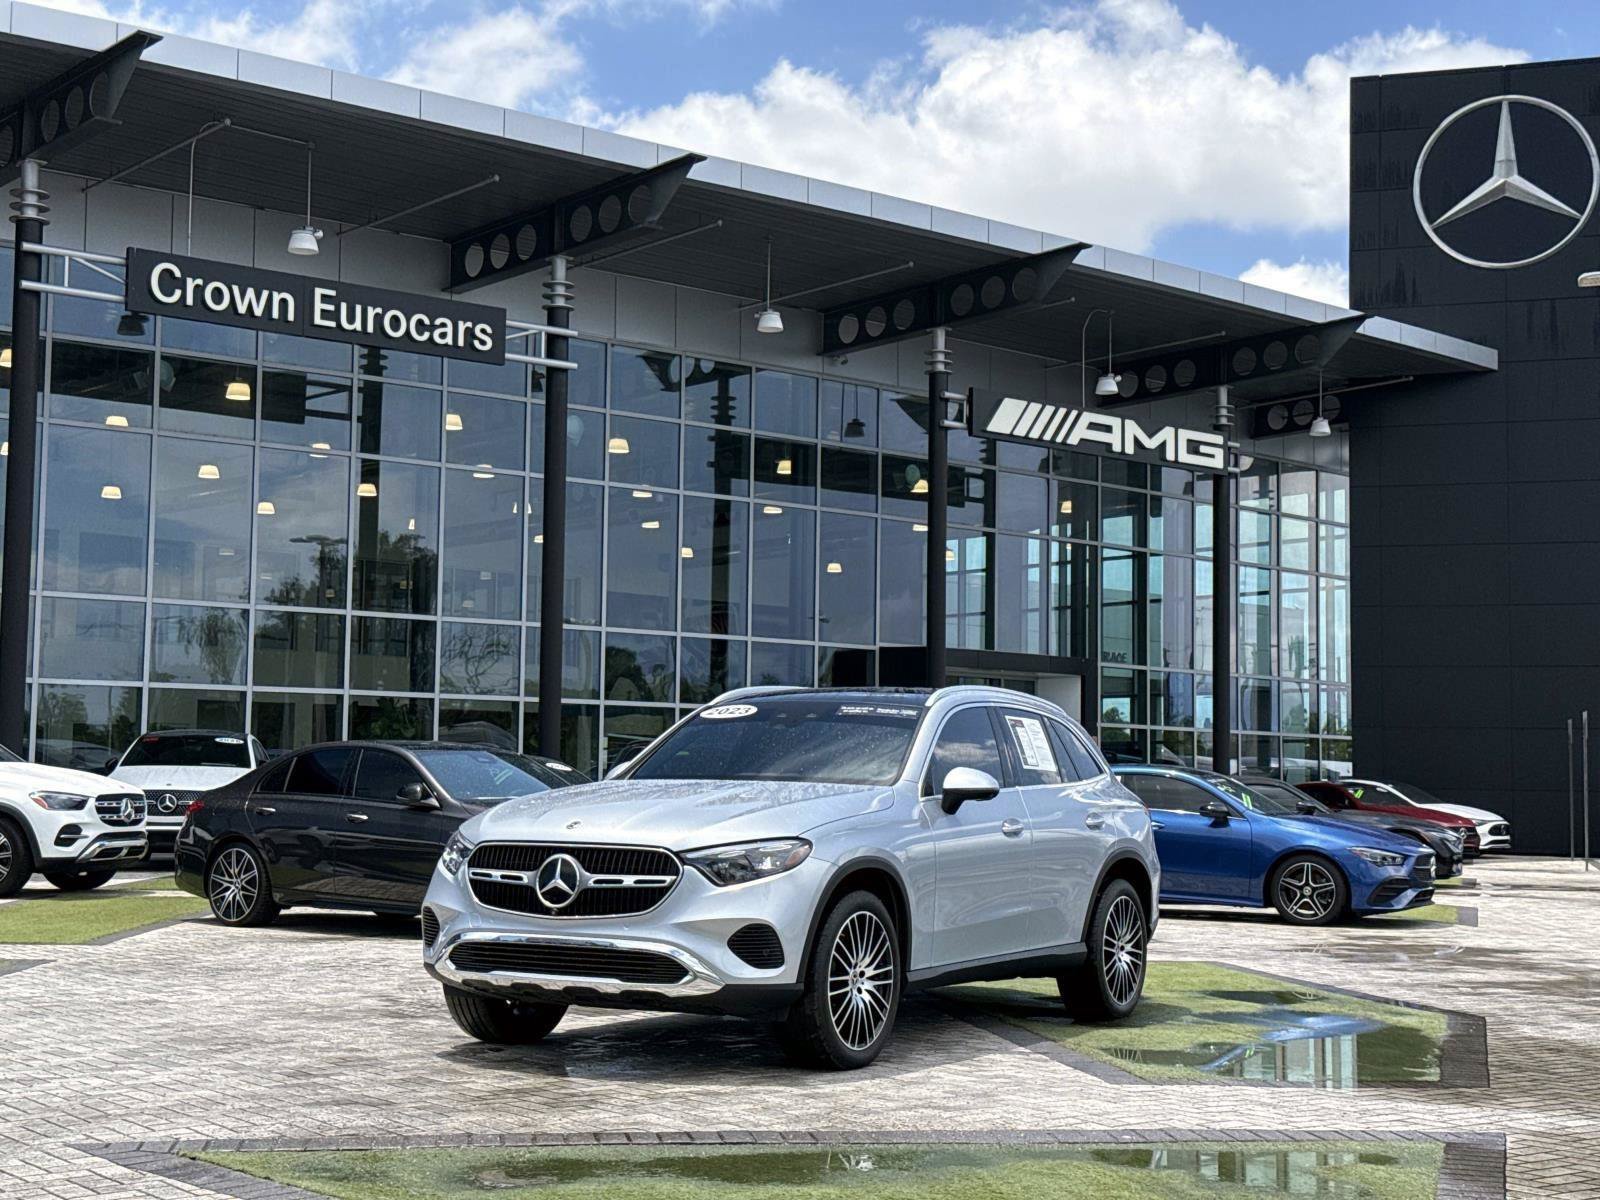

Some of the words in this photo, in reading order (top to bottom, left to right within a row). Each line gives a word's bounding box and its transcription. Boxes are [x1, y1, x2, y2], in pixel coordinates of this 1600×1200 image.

[150, 262, 295, 322] Crown
[313, 287, 493, 351] Eurocars
[1066, 411, 1224, 469] AMG
[704, 707, 752, 716] 2023
